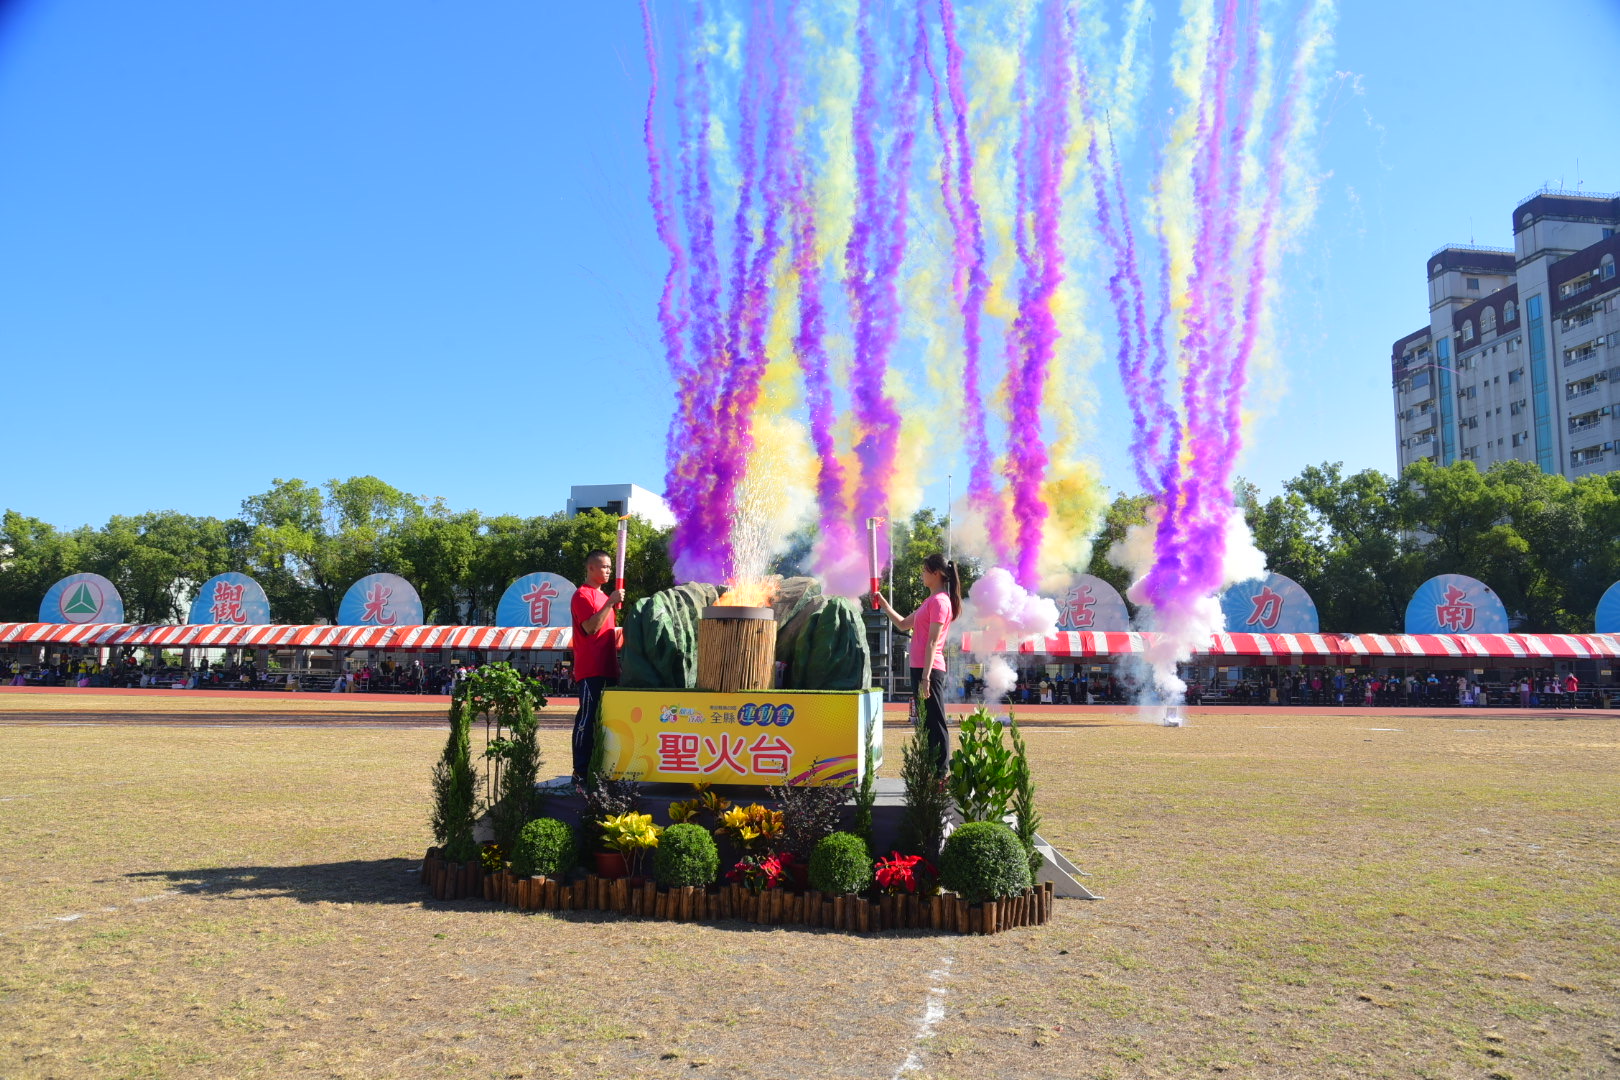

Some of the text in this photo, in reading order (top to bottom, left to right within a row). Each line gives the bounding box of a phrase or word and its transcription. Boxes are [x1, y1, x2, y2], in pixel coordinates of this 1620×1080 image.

[210, 581, 247, 624] 觀
[361, 582, 397, 625] 光
[522, 581, 558, 626] 首
[1059, 584, 1096, 629] 活
[1246, 586, 1284, 629] 力
[1436, 584, 1475, 631] 南
[658, 732, 793, 775] 聖火台
